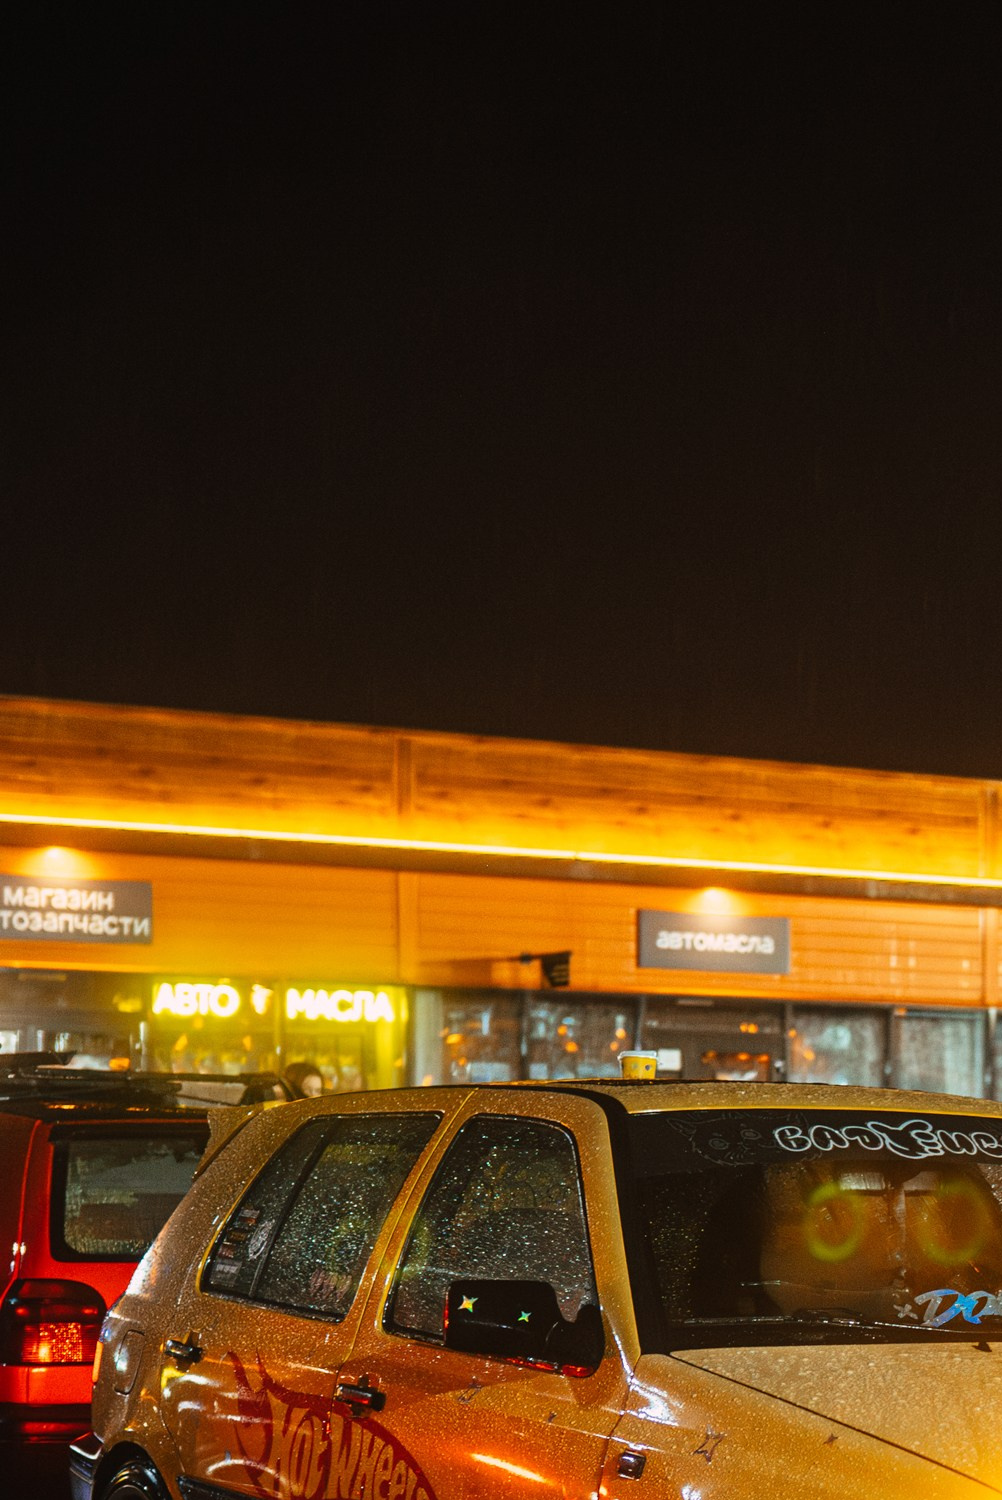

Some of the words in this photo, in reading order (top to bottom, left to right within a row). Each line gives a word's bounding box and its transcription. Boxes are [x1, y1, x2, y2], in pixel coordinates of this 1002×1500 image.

[3, 885, 114, 911] магазин
[656, 930, 775, 955] автомасла
[152, 983, 240, 1017] АВТО
[286, 988, 395, 1022] МАСЛА
